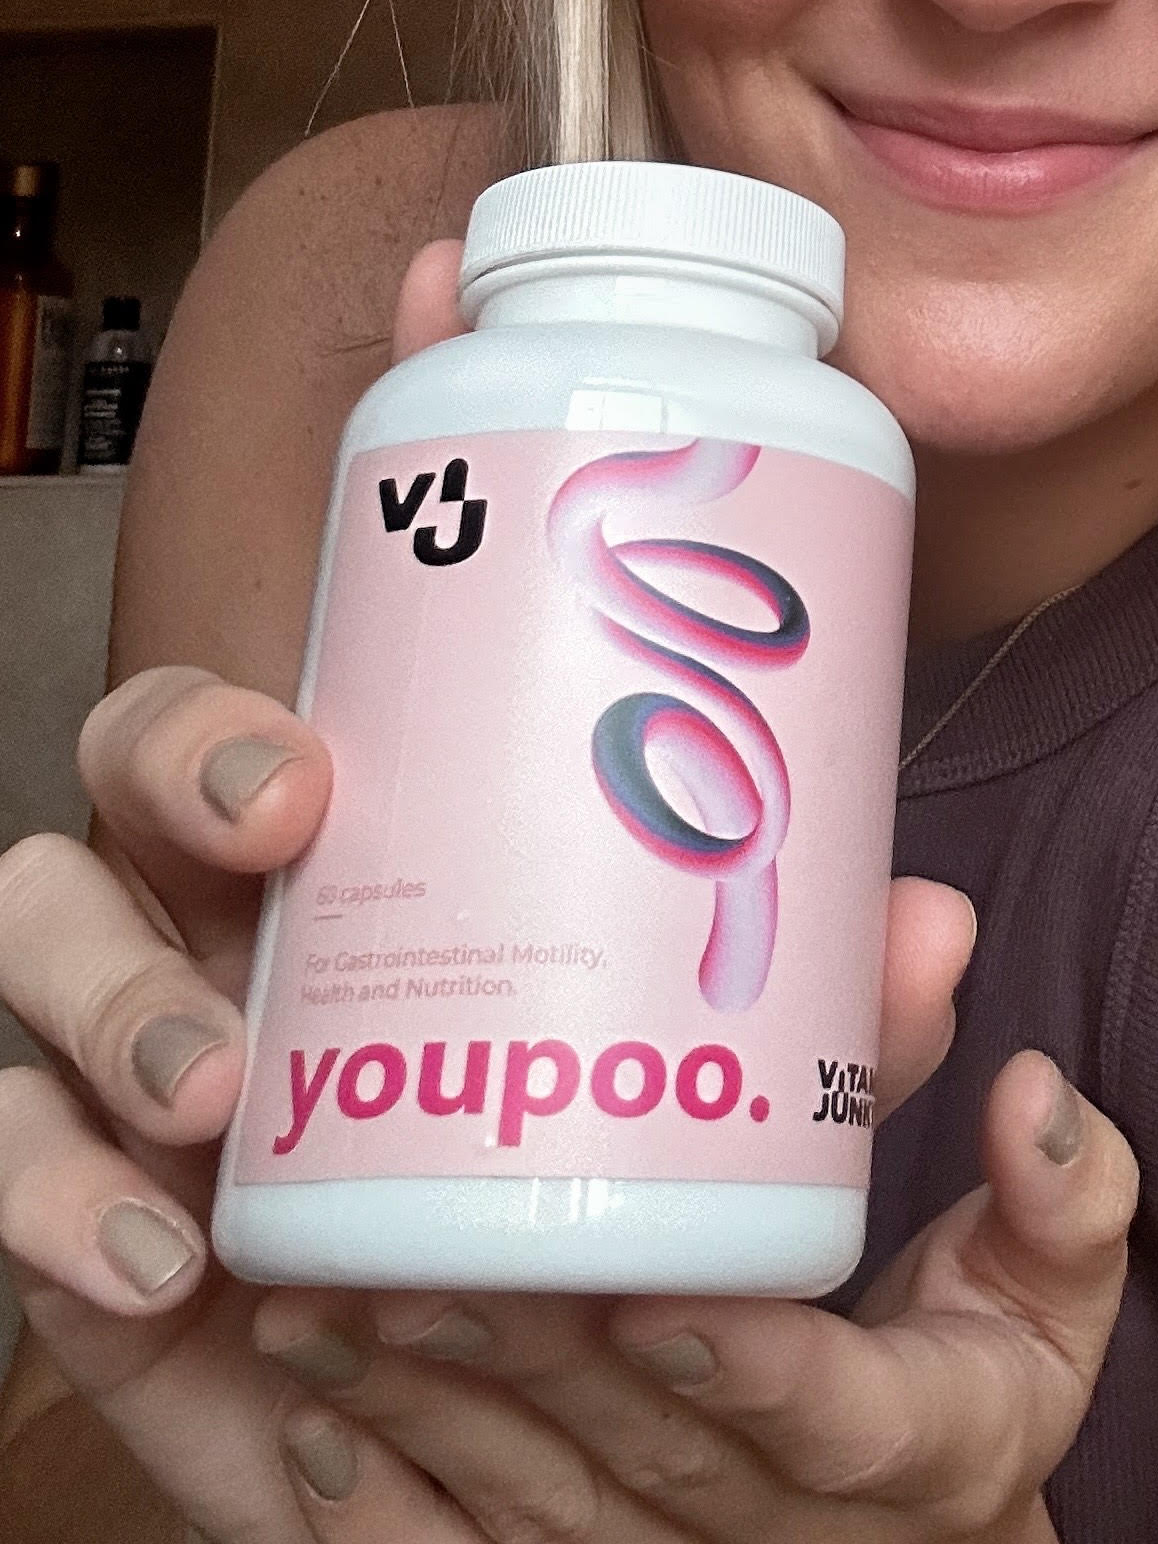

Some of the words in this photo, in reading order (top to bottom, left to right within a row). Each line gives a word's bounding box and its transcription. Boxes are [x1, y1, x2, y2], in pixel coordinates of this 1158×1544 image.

[338, 877, 427, 906] capsules
[304, 953, 330, 974] For
[335, 943, 505, 972] Gastrointestinal
[511, 942, 608, 970] Motility,
[301, 981, 355, 1005] Health
[357, 978, 400, 1002] and
[405, 974, 518, 998] Nutrition.
[272, 1039, 770, 1155] youpoo.
